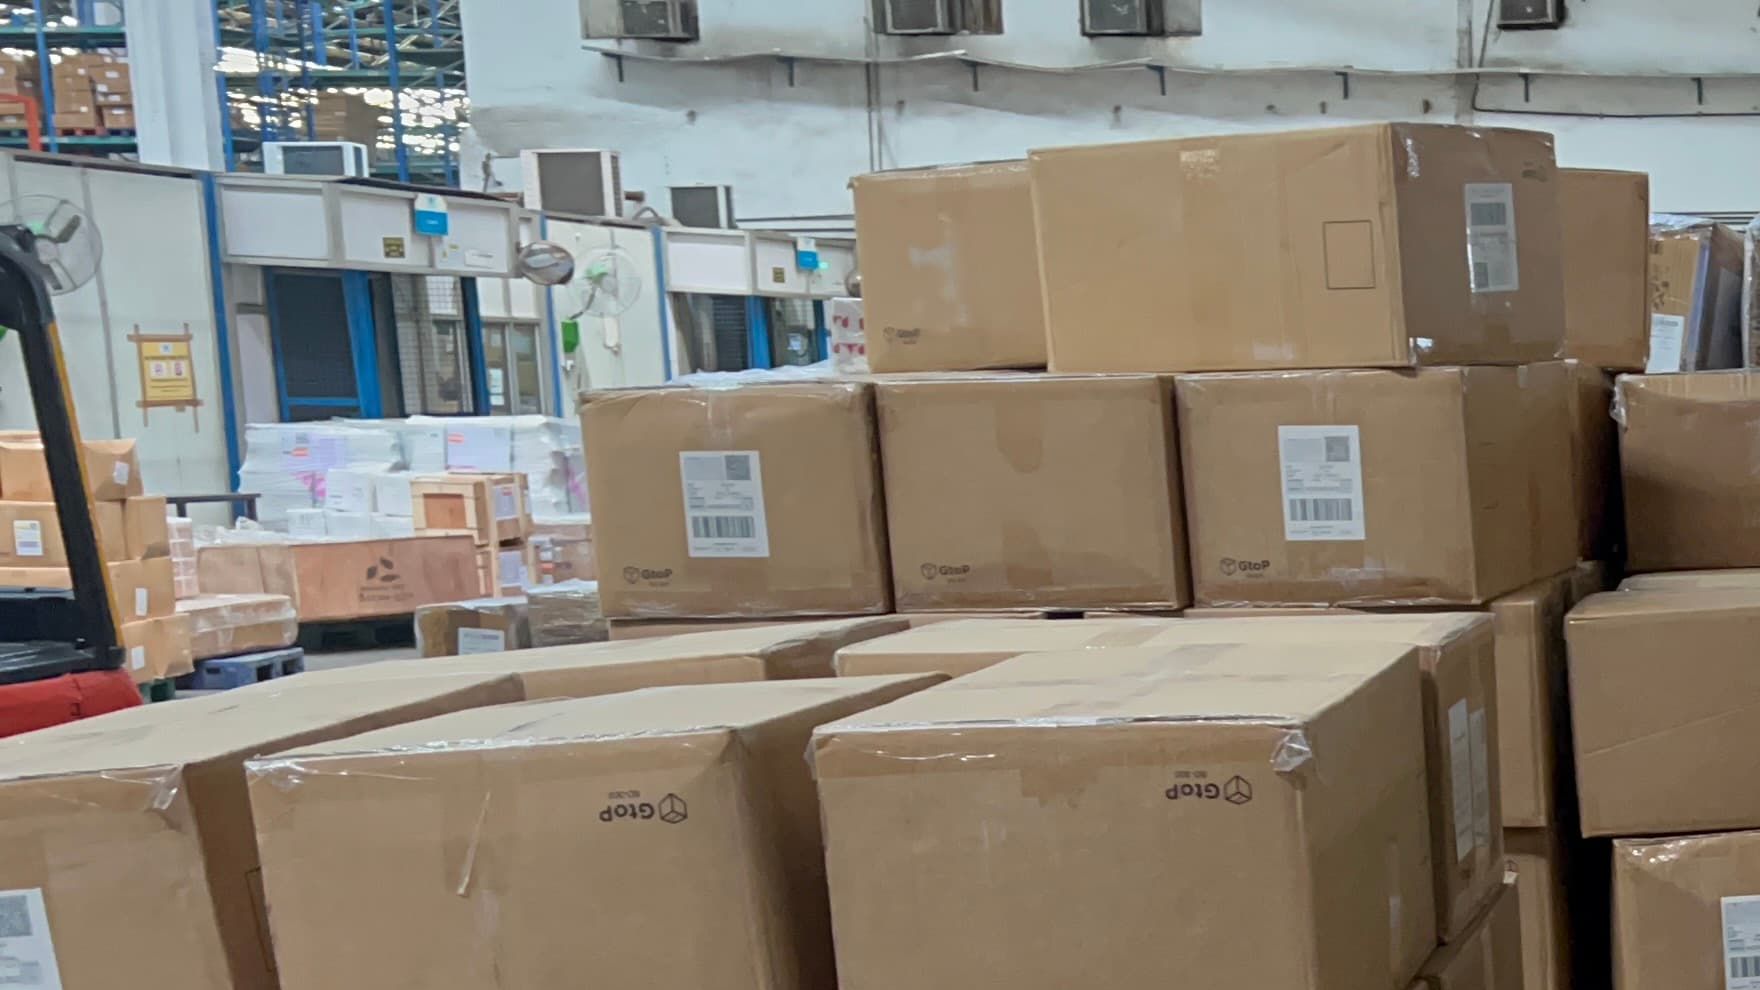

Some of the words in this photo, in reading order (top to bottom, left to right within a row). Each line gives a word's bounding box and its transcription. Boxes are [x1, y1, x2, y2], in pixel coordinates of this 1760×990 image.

[1238, 560, 1270, 571] GtoP
[1165, 783, 1220, 801] GtoP
[599, 803, 655, 822] GtoP
